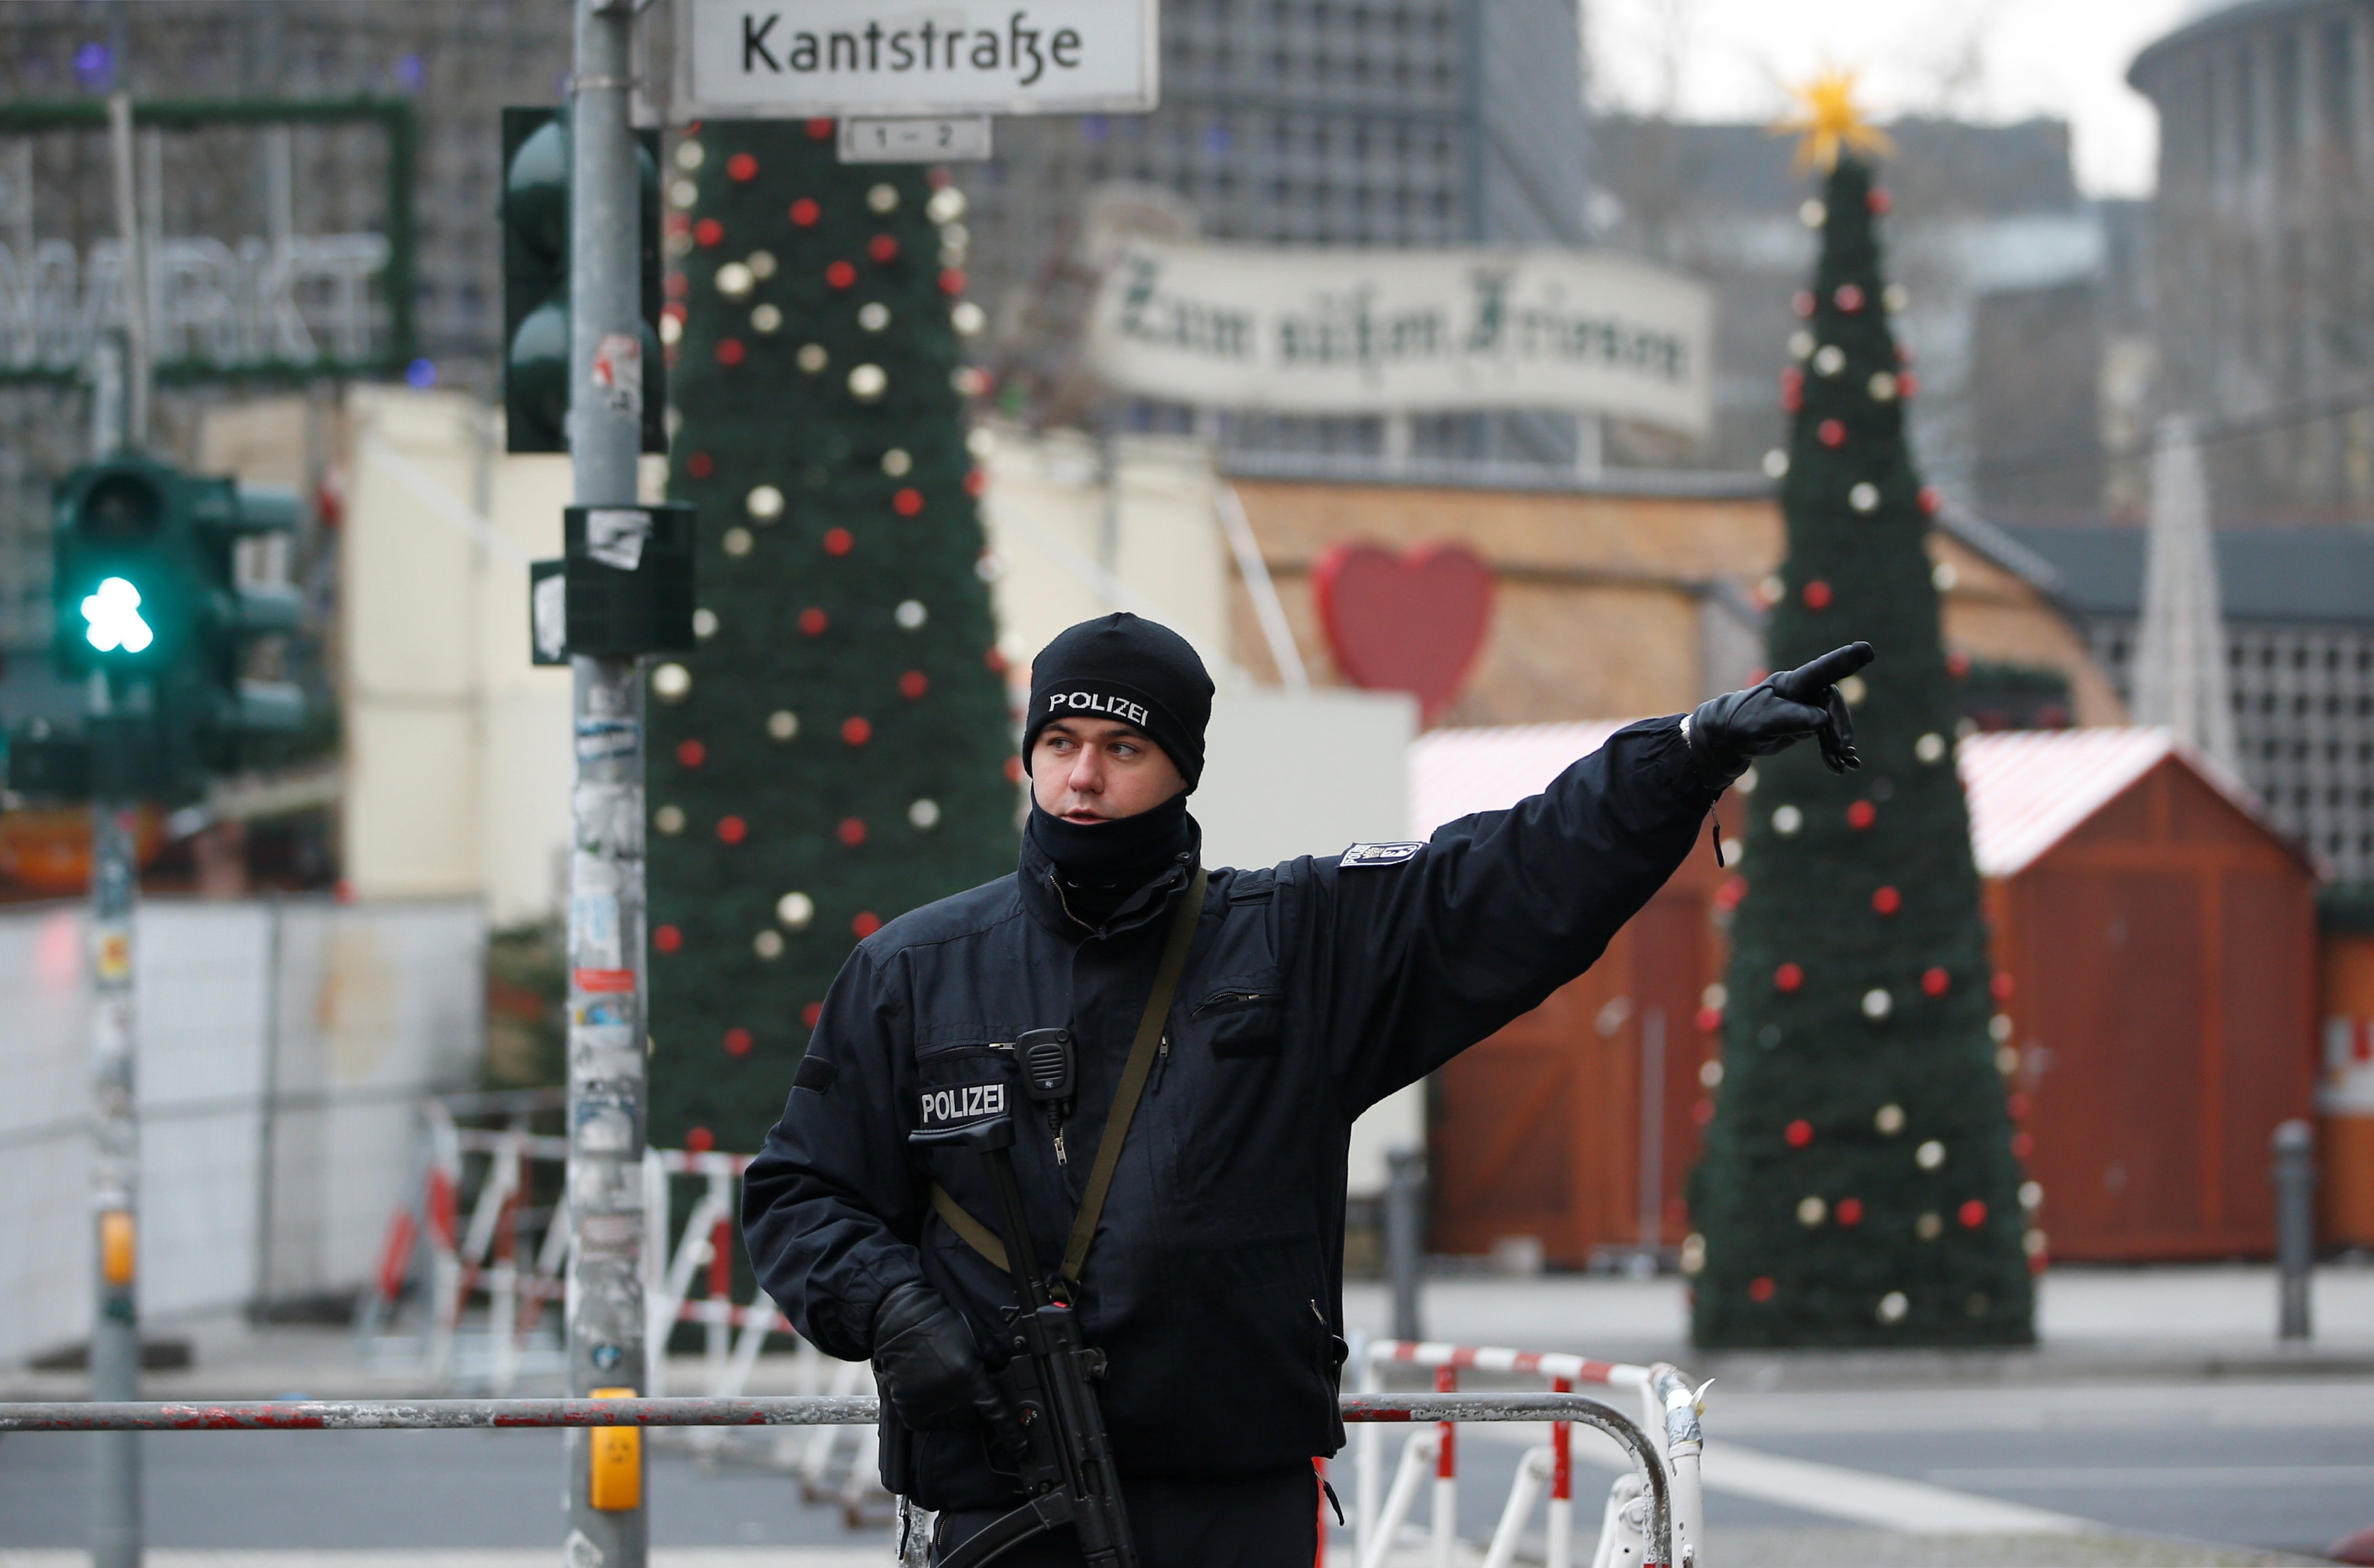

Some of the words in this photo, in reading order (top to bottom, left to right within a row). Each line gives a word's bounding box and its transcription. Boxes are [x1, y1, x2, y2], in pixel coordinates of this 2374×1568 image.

[741, 10, 1083, 87] Kantstraße
[1049, 691, 1149, 726] POLIZEI
[921, 1084, 1005, 1124] POLIZEI
